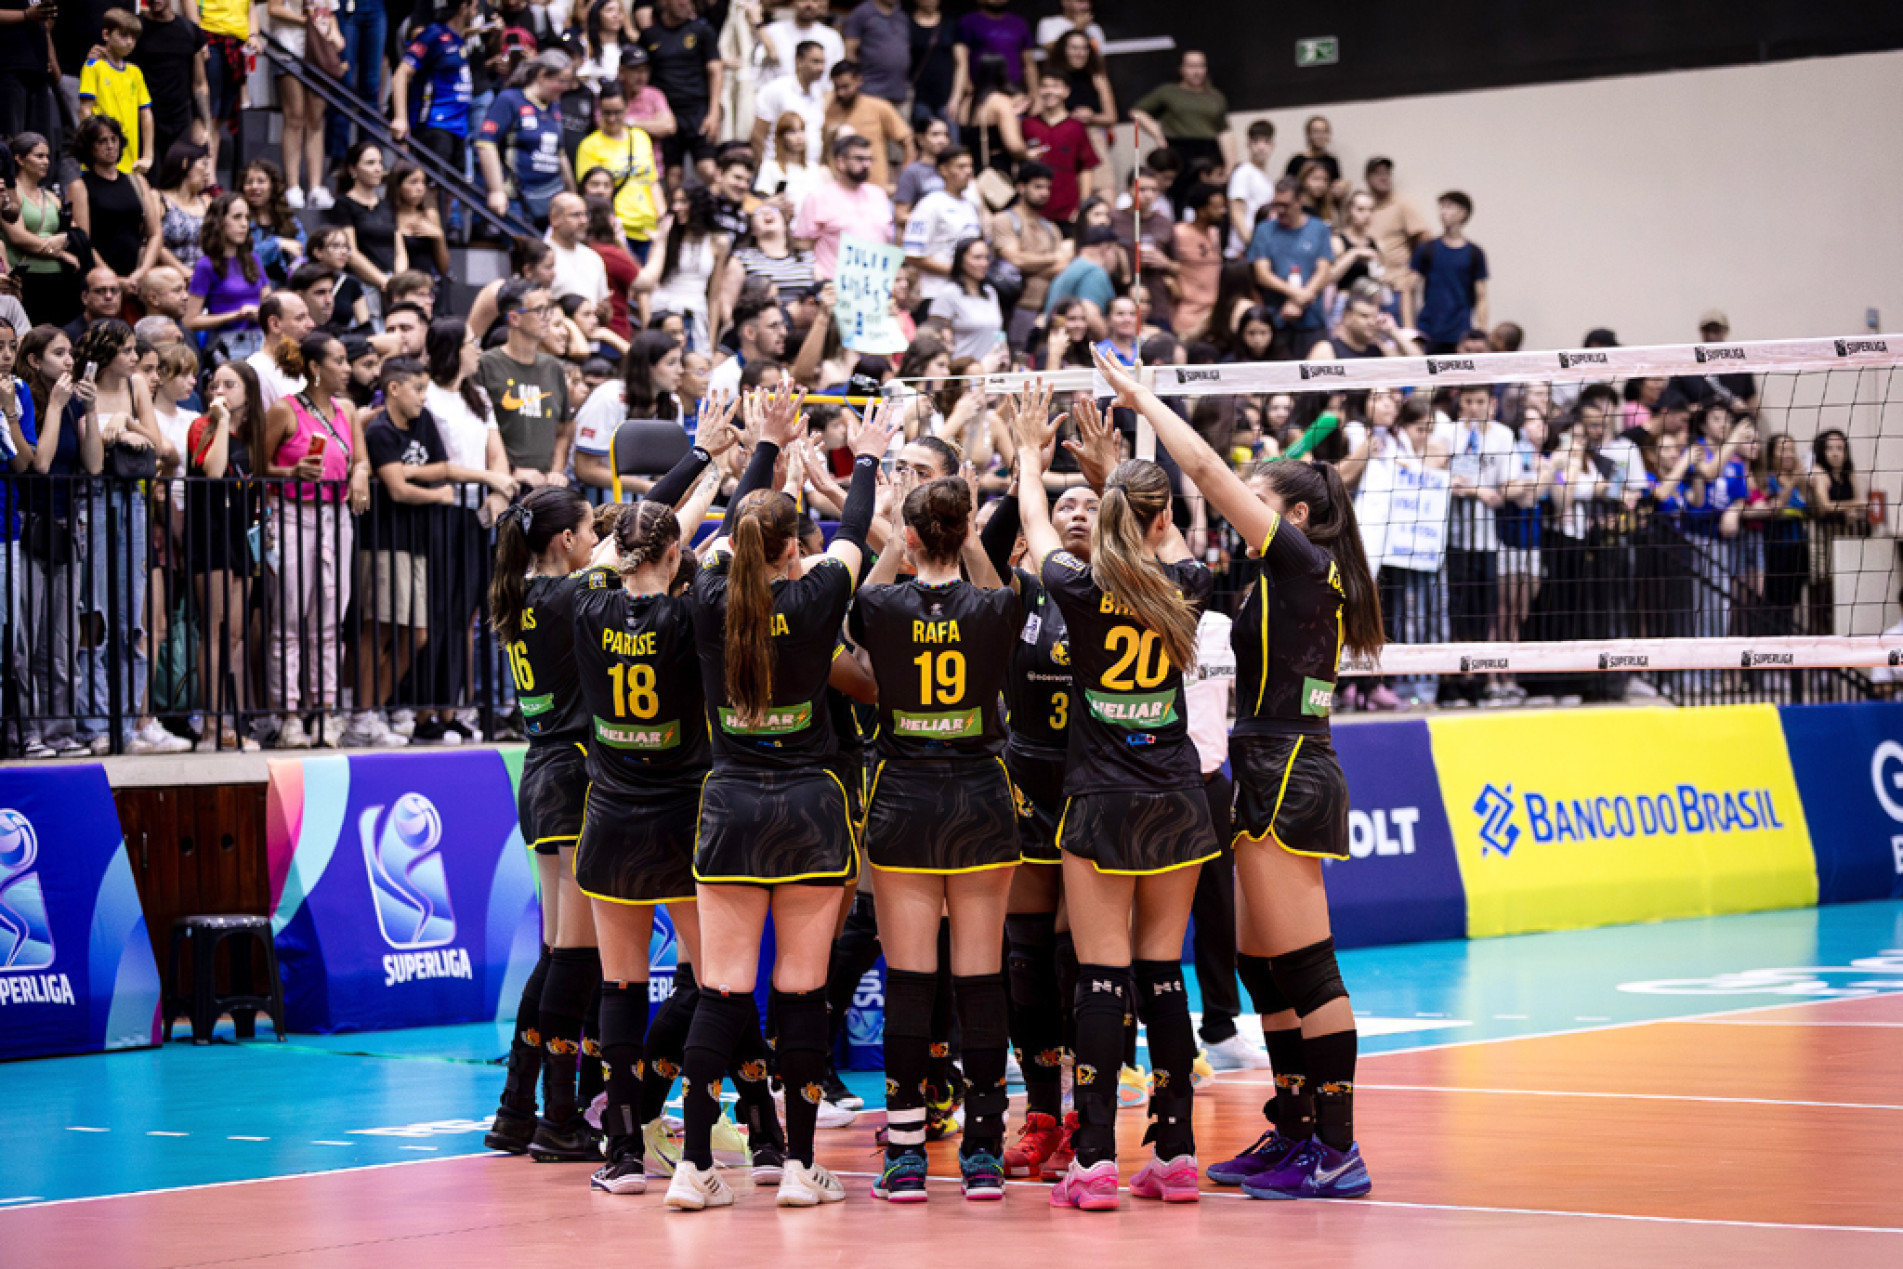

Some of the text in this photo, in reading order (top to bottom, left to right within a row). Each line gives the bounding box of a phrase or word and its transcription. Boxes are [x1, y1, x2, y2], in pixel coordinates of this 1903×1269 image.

[1705, 347, 1746, 361] SUPERLIGA
[1847, 341, 1888, 355] SUPERLIGA
[1438, 360, 1475, 372] SUPERLIGA
[1570, 353, 1608, 366] SUPERLIGA
[912, 619, 961, 644] RAFA
[602, 628, 657, 656] PARISE
[506, 640, 535, 690] 16
[1100, 625, 1170, 691] 20
[1471, 658, 1509, 670] SUPERLIGA
[1609, 655, 1648, 668] SUPERLIGA
[1753, 653, 1794, 666] SUPERLIGA
[914, 650, 966, 704] 19
[608, 662, 659, 719] 18
[1050, 691, 1069, 729] 3
[1092, 700, 1163, 719] HELIAR
[599, 723, 662, 743] HELIAR
[899, 717, 954, 731] HELIAR
[1524, 784, 1784, 843] BANCO DO BRASIL
[382, 948, 473, 987] SUPERLIGA
